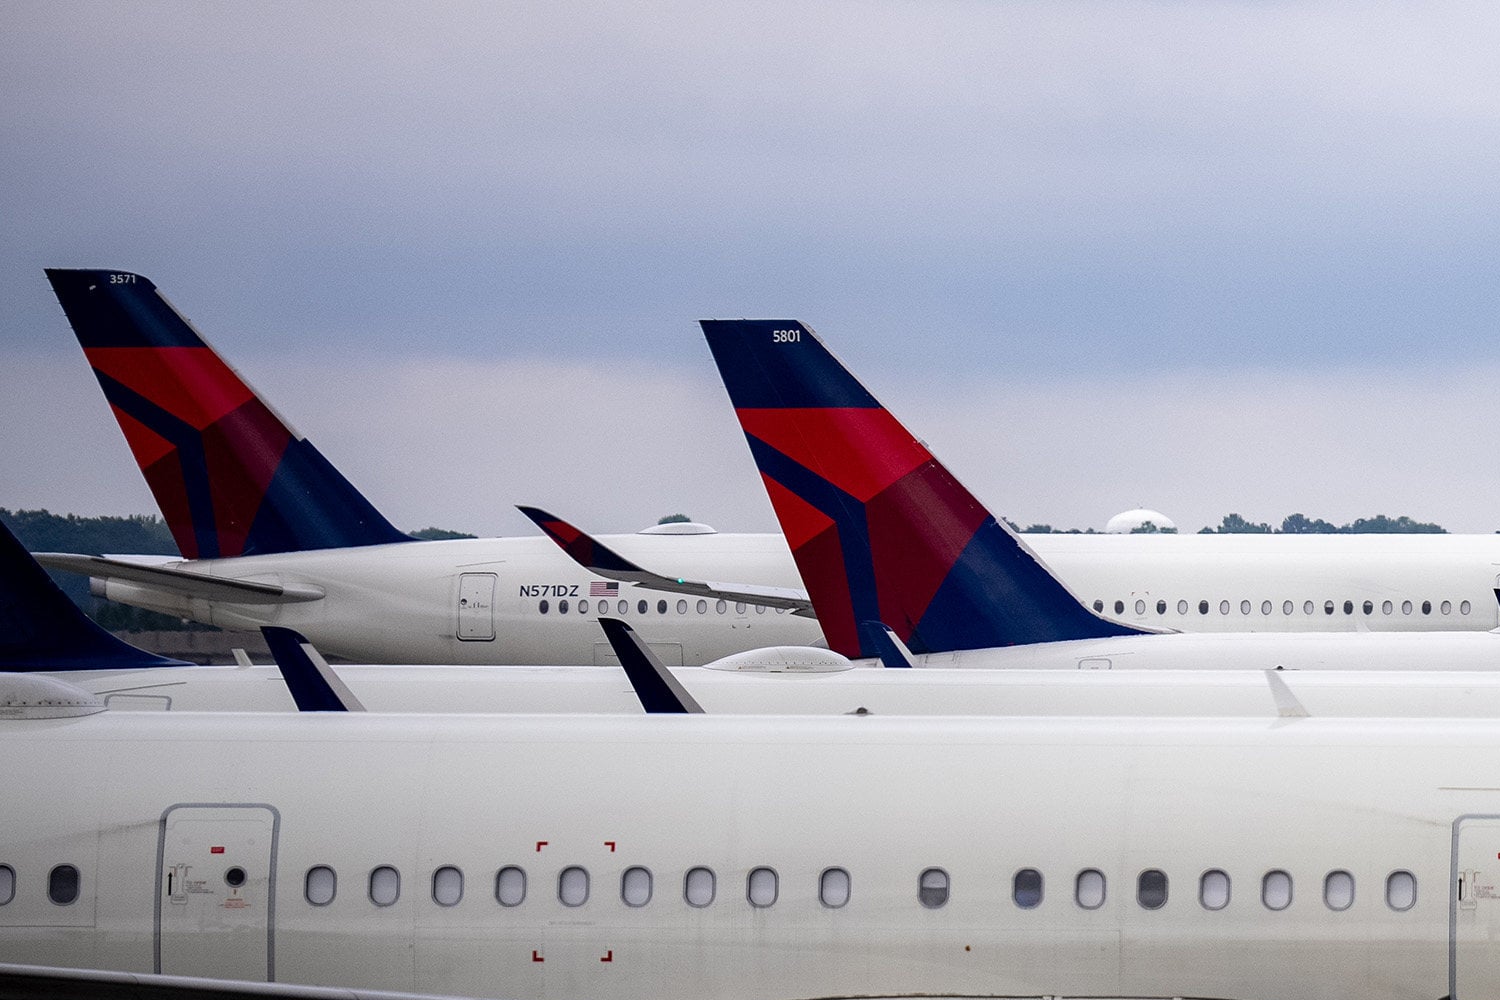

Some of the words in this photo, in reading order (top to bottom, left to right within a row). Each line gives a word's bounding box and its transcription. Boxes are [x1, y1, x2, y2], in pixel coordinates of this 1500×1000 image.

[109, 274, 137, 284] 3571
[773, 329, 801, 343] 5801
[519, 585, 579, 597] N571DZ
